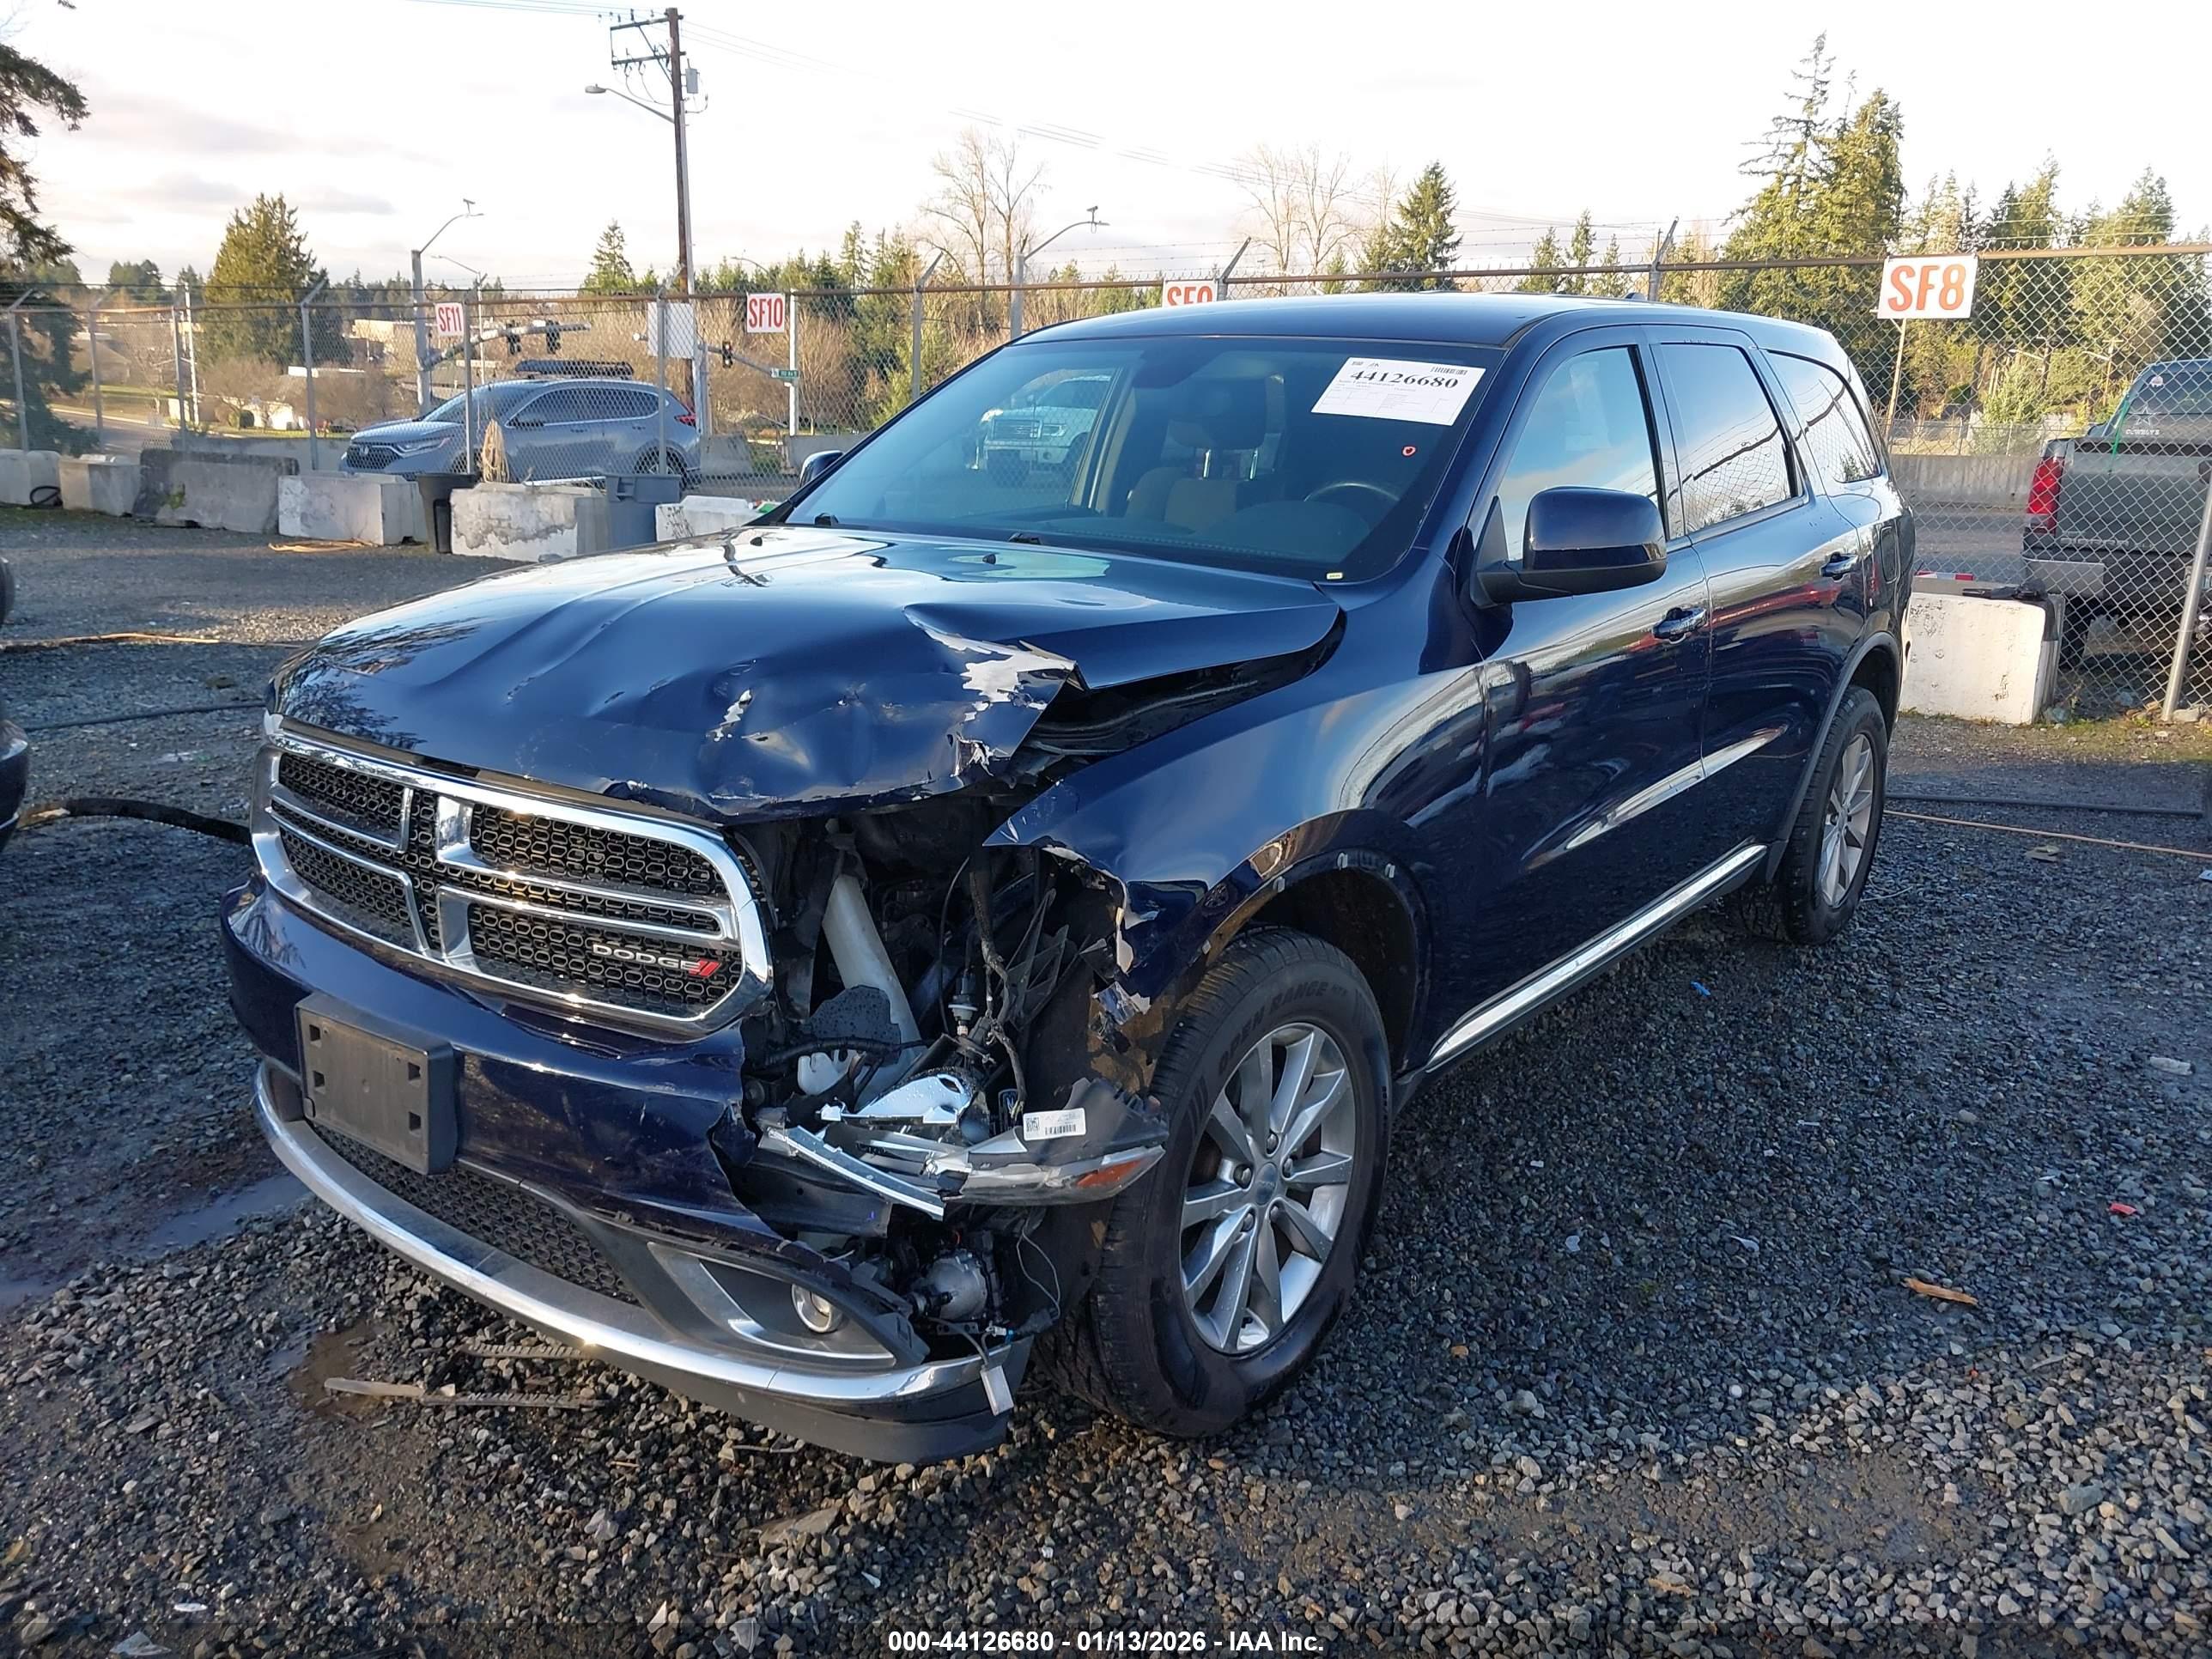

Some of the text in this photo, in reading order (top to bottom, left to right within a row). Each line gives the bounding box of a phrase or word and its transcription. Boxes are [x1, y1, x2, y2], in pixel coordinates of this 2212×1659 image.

[1887, 264, 1966, 312] SF8
[438, 307, 462, 332] SF11
[749, 297, 783, 328] SF10
[1350, 369, 1459, 389] 44126680
[592, 944, 701, 972] DODGE
[1218, 980, 1329, 1076] OPEN RANGE
